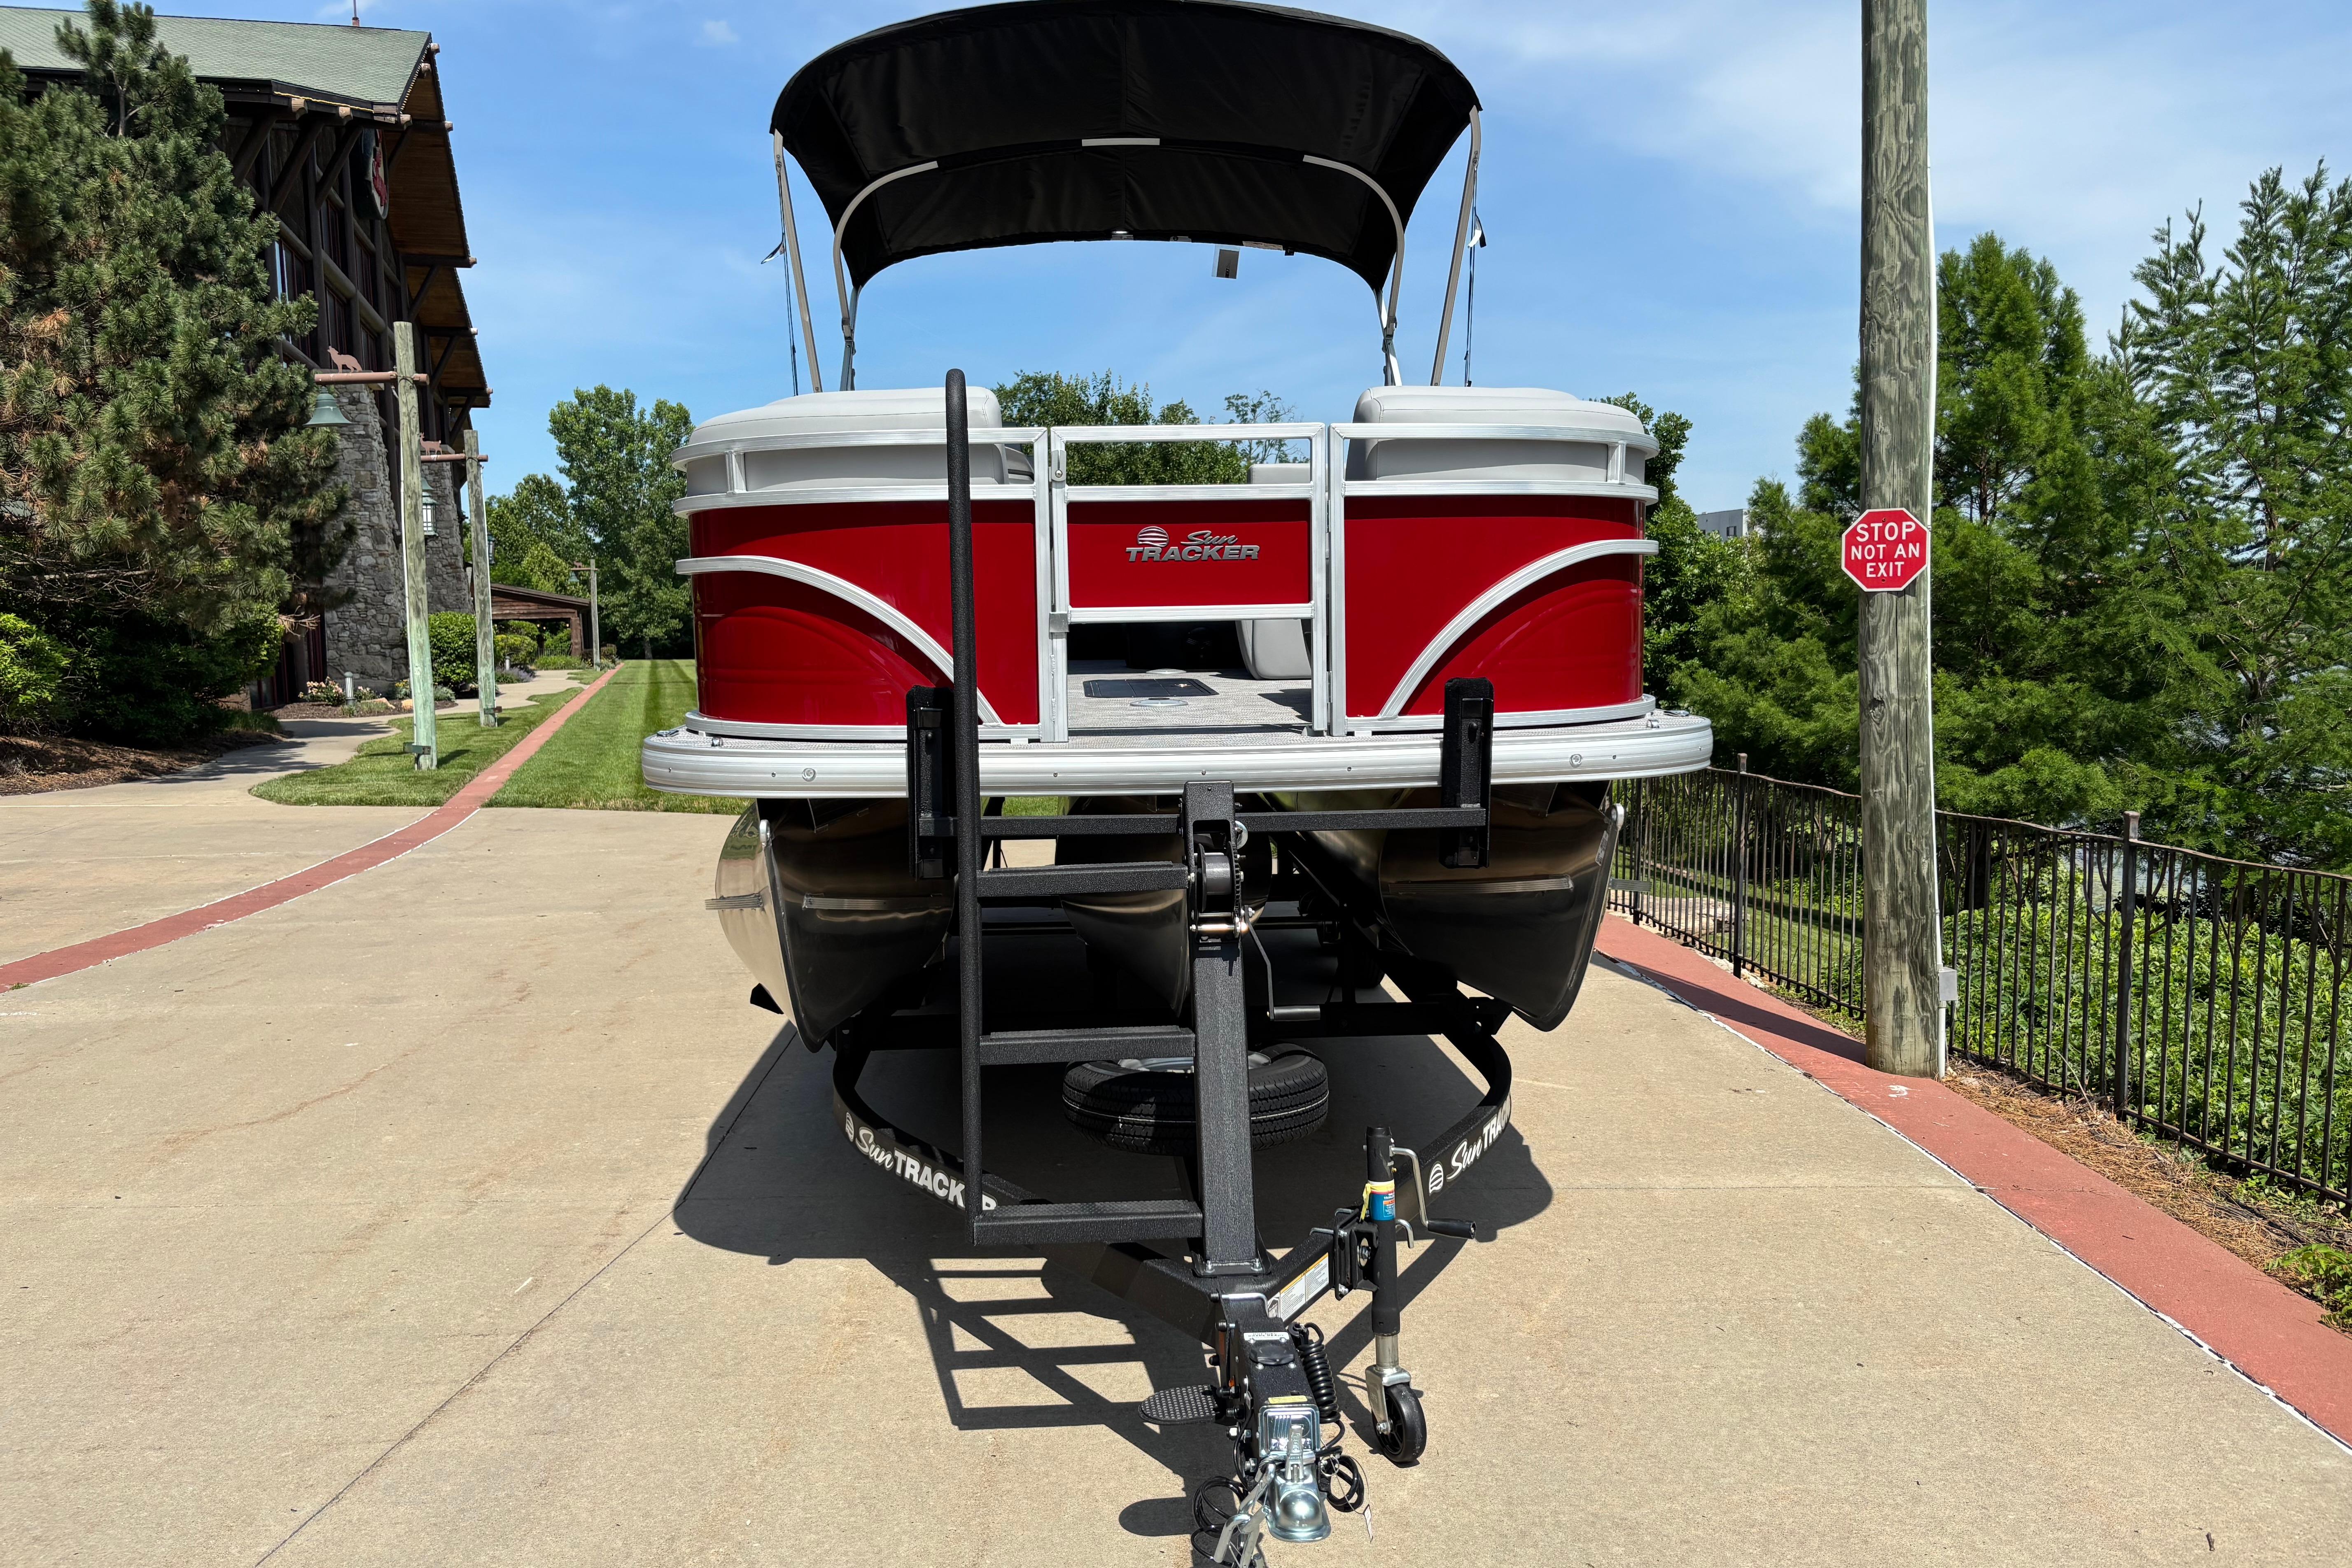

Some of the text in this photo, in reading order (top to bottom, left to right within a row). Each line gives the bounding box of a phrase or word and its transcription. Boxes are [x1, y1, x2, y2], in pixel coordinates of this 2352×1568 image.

[1180, 530, 1238, 545] Sun
[1856, 521, 1916, 542] STOP
[1126, 545, 1260, 562] TRACKER
[1851, 542, 1920, 560] NOT AN
[1866, 561, 1904, 577] EXIT
[856, 1128, 894, 1169] Sun
[1446, 1138, 1482, 1180] Sun
